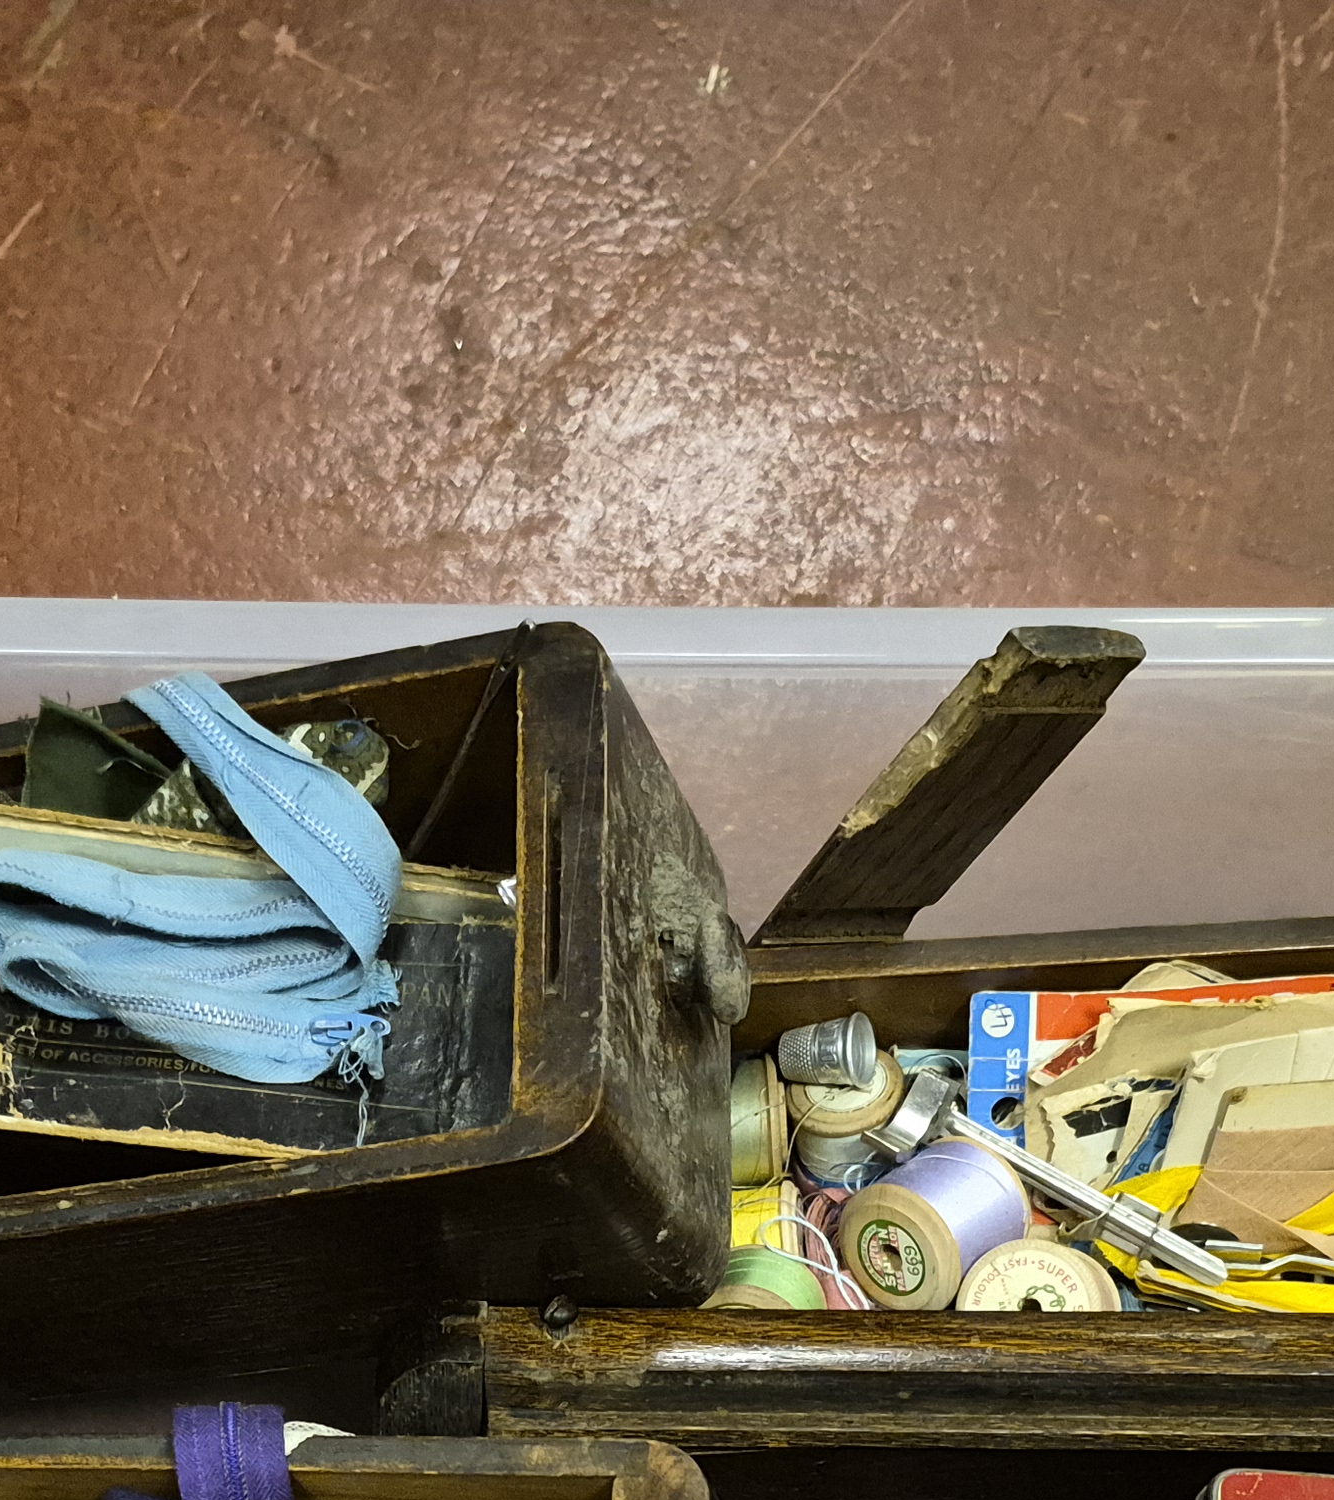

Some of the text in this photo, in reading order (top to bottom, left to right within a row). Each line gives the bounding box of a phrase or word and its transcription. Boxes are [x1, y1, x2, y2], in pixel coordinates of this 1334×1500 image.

[399, 981, 476, 1008] PANY
[4, 1013, 132, 1040] THIS BO
[41, 1048, 64, 1061] OF
[1005, 1047, 1022, 1092] EYES
[1002, 1256, 1027, 1272] FAST
[1037, 1259, 1078, 1294] SUPER
[972, 1267, 1001, 1307] COLOUR
